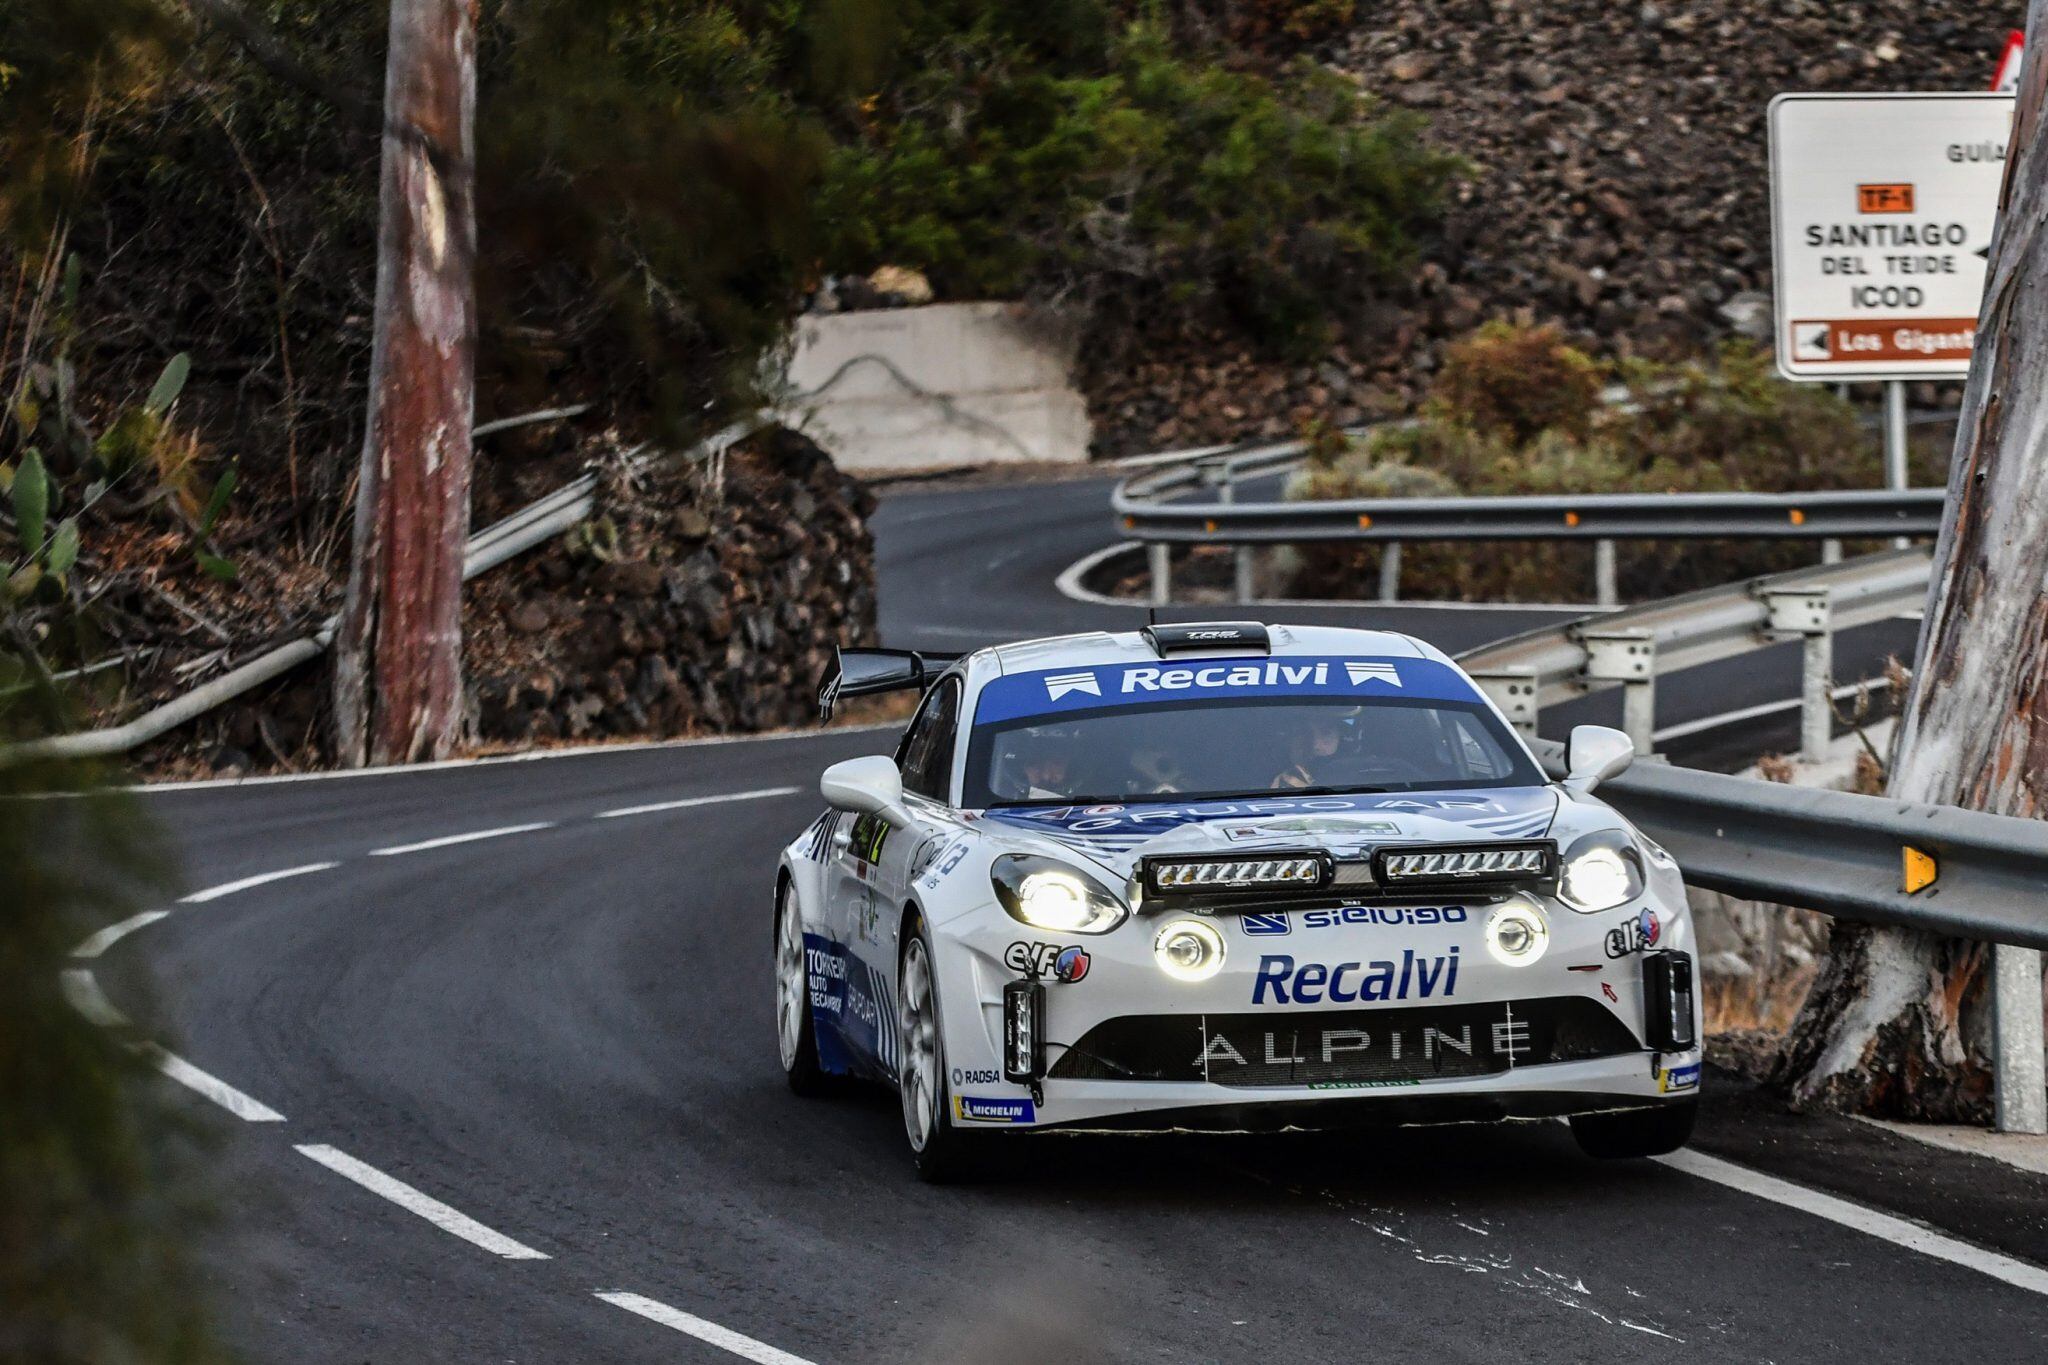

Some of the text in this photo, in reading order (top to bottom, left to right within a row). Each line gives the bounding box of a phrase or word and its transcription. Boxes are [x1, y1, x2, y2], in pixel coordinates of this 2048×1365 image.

[1947, 140, 2006, 162] GUÍA
[1861, 189, 1912, 208] TF-1
[1806, 223, 1968, 247] SANTIAGO
[1822, 255, 1957, 275] DEL TEIDE
[1851, 286, 1924, 308] ICOD
[1838, 329, 1883, 352] Los
[1121, 662, 1329, 693] Recalvi
[1068, 800, 1356, 831] GRUPO
[1005, 941, 1063, 976] elf
[809, 975, 828, 992] AUTO
[1251, 946, 1460, 1005] Recalvi
[1192, 1021, 1531, 1065] ALPINE
[965, 1070, 1000, 1084] RADSA
[972, 1105, 1023, 1117] MICHELIN
